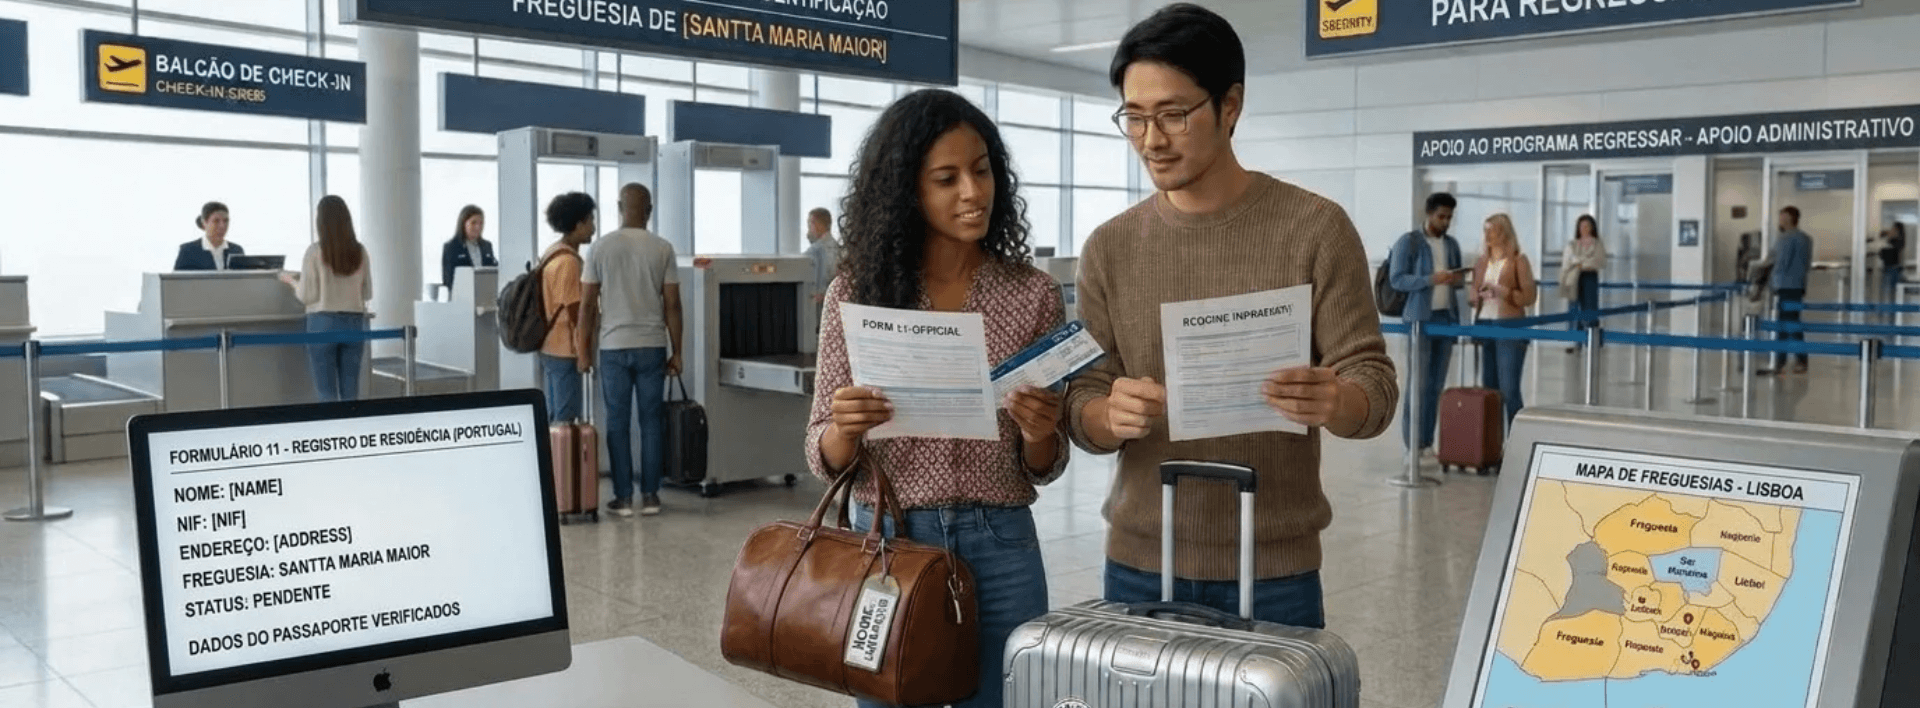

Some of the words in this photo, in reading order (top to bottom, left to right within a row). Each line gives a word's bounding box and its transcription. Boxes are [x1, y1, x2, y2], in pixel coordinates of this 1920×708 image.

[649, 8, 676, 32] DE
[769, 25, 825, 52] MARIA
[1432, 0, 1511, 26] PARA
[240, 64, 263, 83] DE
[1421, 139, 1464, 157] APOIO
[1468, 138, 1488, 155] AO
[1492, 134, 1579, 154] PROGRAMA
[1583, 128, 1682, 150] REGRESSAR
[1696, 125, 1751, 145] APOIO
[1756, 116, 1914, 143] ADMINISTRATIVO
[169, 443, 263, 465] FORMULÁRIO
[267, 443, 280, 455] 11
[291, 434, 357, 454] REGISTRO
[360, 433, 377, 448] DE
[453, 422, 523, 442] (PORTUGAL)
[174, 485, 225, 503] NOME:
[229, 478, 283, 501] [NAME]
[1576, 463, 1615, 481] MAPA
[1617, 466, 1637, 483] DE
[1640, 470, 1734, 493] FREGUESIAS
[1745, 481, 1804, 501] LISBOA
[177, 515, 208, 532] NIF:
[211, 510, 247, 531] [NIF]
[179, 537, 270, 560] ENDEREÇO:
[273, 526, 353, 553] [ADDRESS]
[182, 564, 275, 589] FREGUESIA:
[278, 555, 336, 577] SANTTA
[338, 550, 384, 569] MARIA
[386, 544, 431, 563] MAIOR
[184, 595, 250, 618] STATUS:
[253, 583, 332, 609] PENDENTE
[189, 634, 244, 656] DADOS
[247, 630, 270, 647] DO
[272, 615, 369, 643] PASSAPORTE
[371, 602, 461, 628] VERIFICADOS
